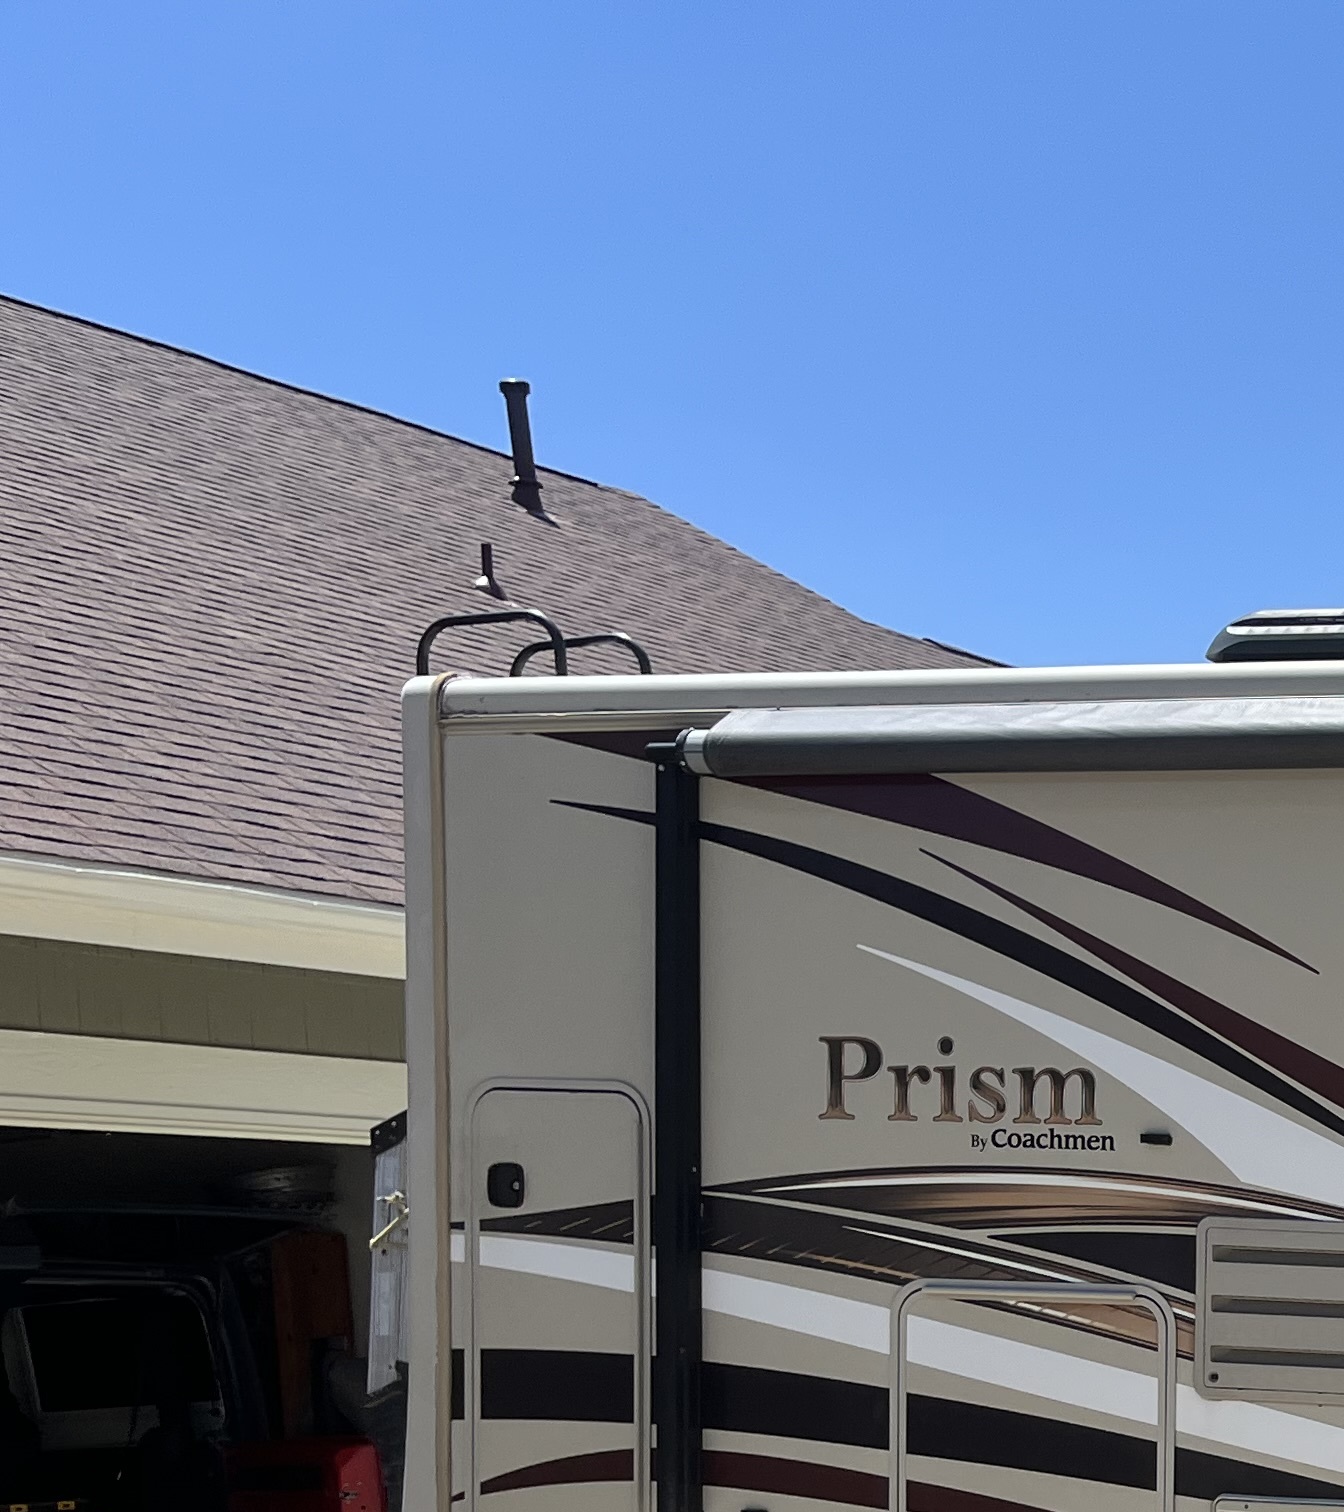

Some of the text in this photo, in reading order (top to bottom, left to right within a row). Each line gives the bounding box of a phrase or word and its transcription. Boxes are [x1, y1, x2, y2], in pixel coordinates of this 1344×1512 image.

[818, 1036, 1103, 1125] Prism
[971, 1128, 1116, 1152] By Coachmen
